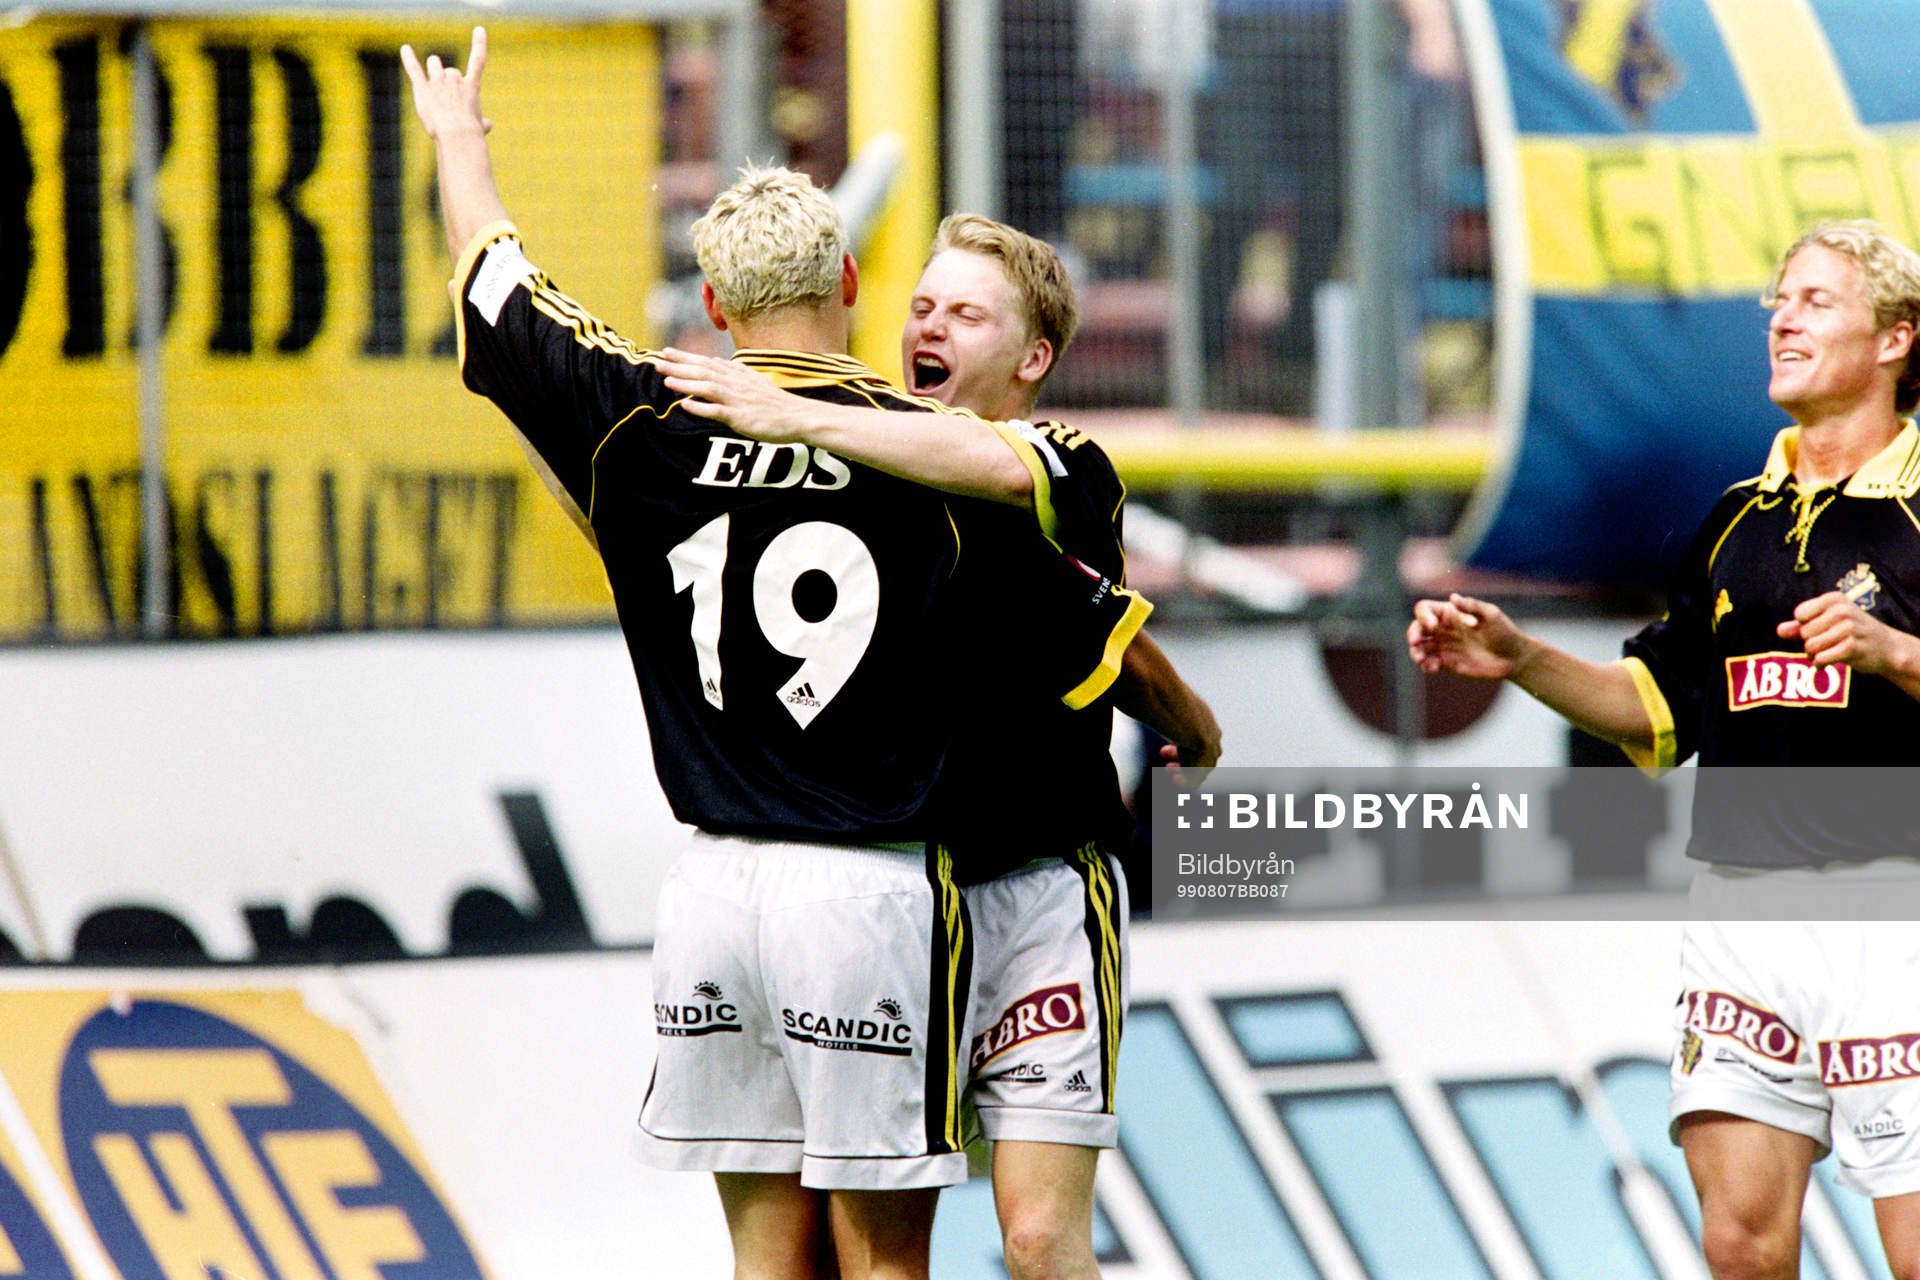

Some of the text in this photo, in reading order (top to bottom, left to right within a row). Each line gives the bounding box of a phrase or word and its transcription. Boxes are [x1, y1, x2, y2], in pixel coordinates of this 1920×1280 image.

[692, 436, 851, 491] EDS
[666, 512, 880, 730] 19
[786, 695, 821, 708] adidas
[1738, 658, 1841, 702] ÅBRO
[782, 1008, 912, 1044] SCANDIC
[816, 1039, 859, 1050] HOTELS
[972, 992, 1078, 1068] ÅBRO
[1689, 991, 1796, 1057] ÅBRO
